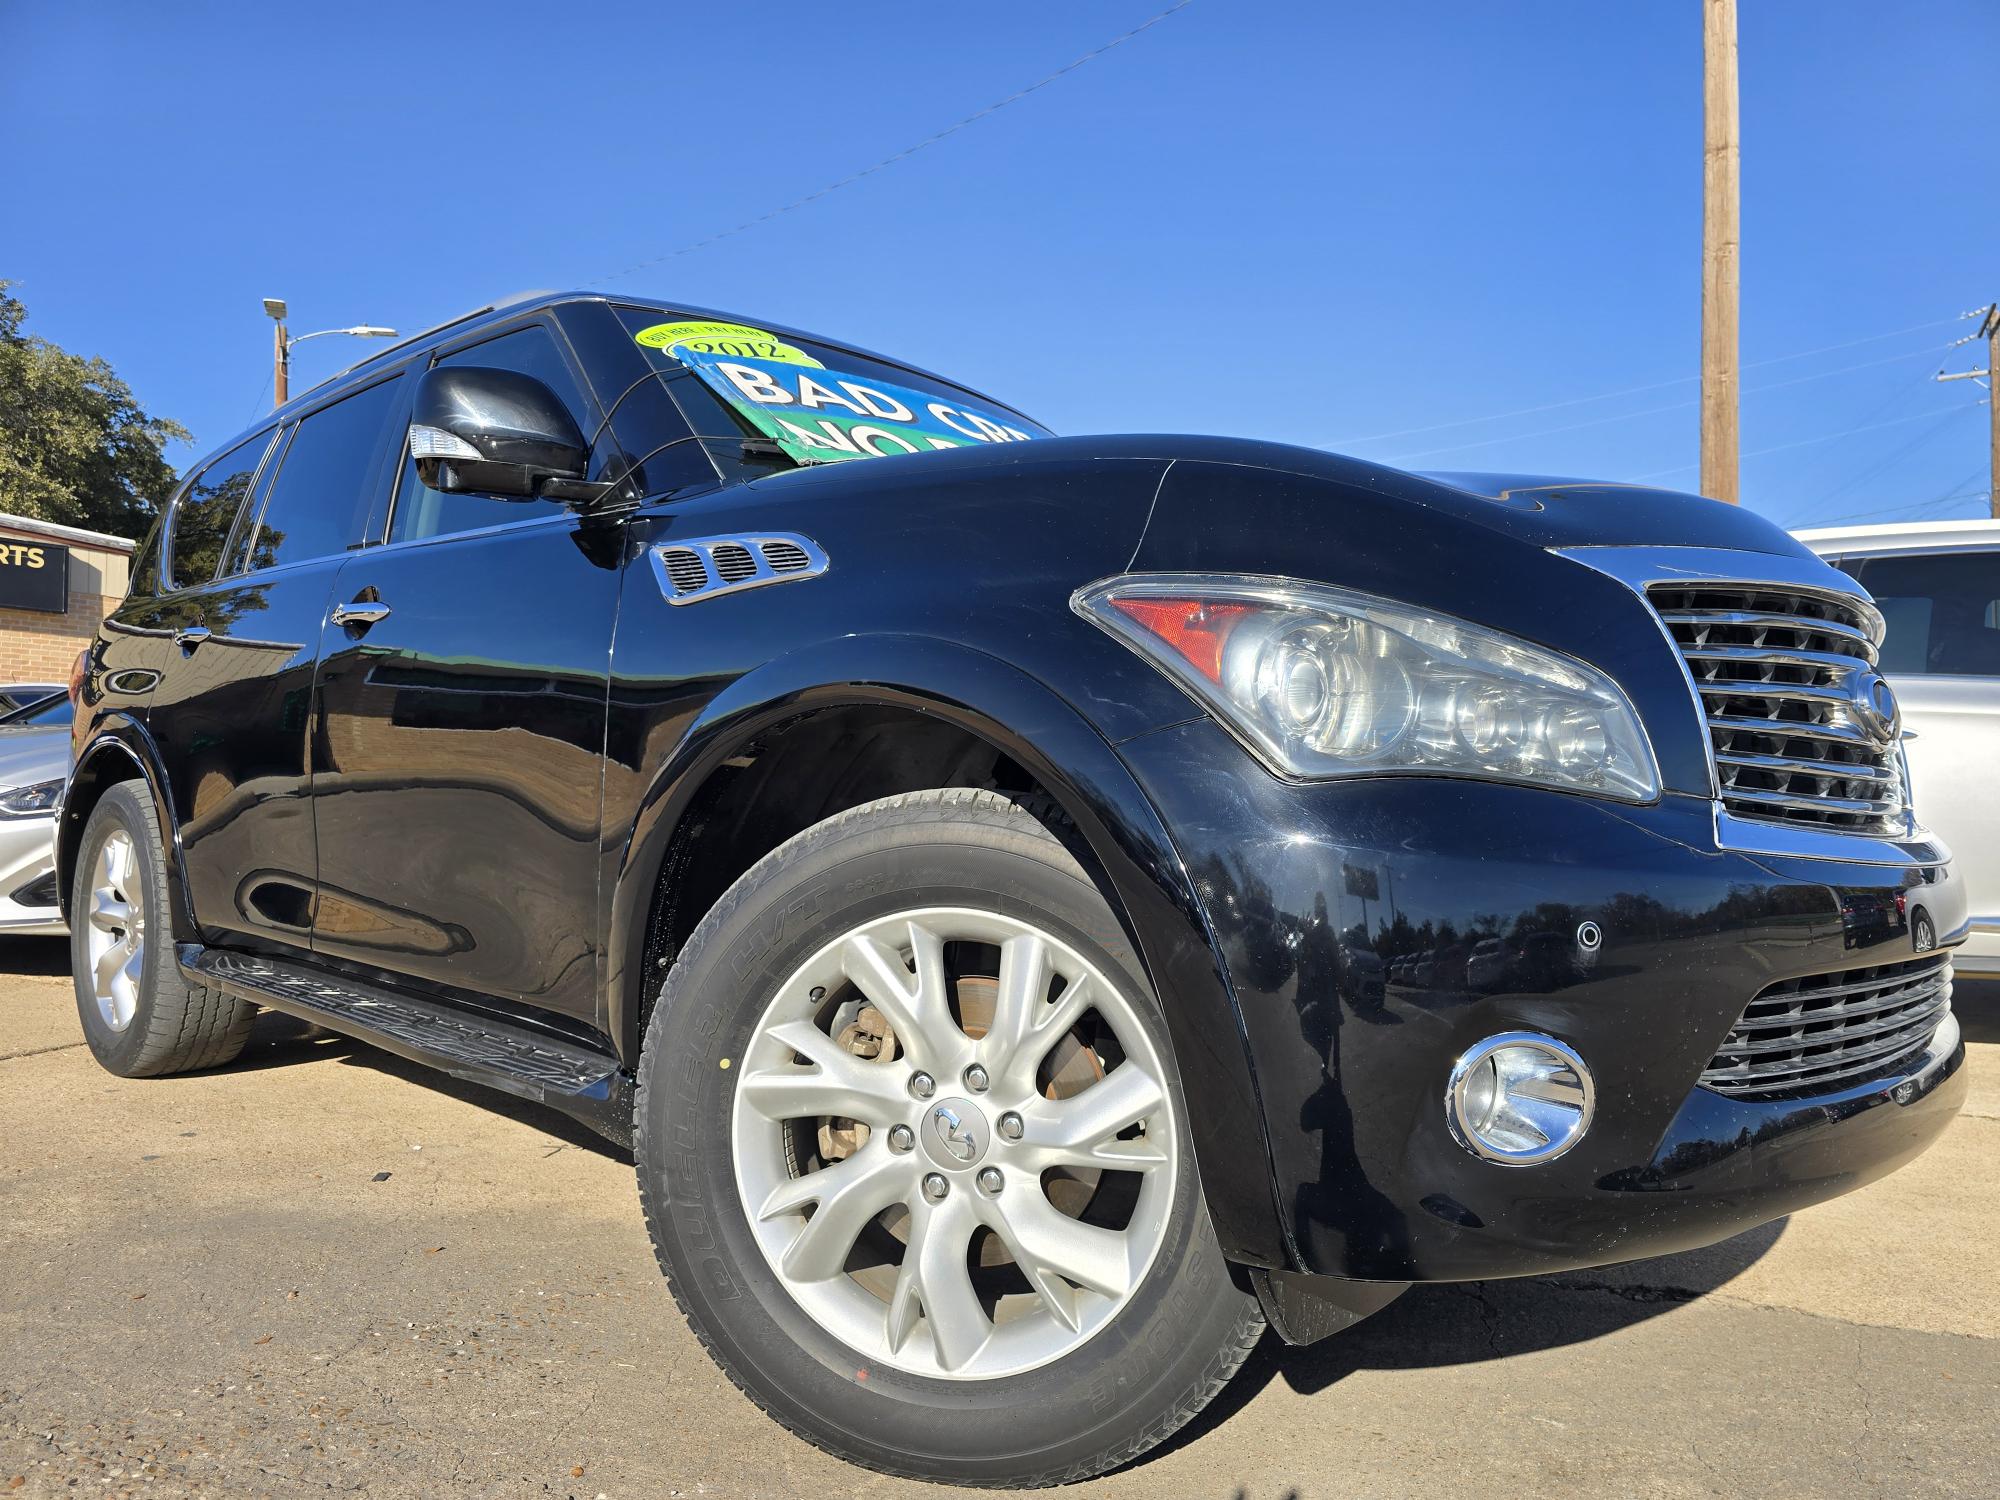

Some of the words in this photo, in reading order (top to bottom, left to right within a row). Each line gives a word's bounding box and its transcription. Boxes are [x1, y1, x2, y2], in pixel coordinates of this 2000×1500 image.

[693, 342, 786, 359] 2012
[716, 363, 914, 422] BAD
[776, 418, 920, 458] NO
[671, 1002, 743, 1301] DUELER
